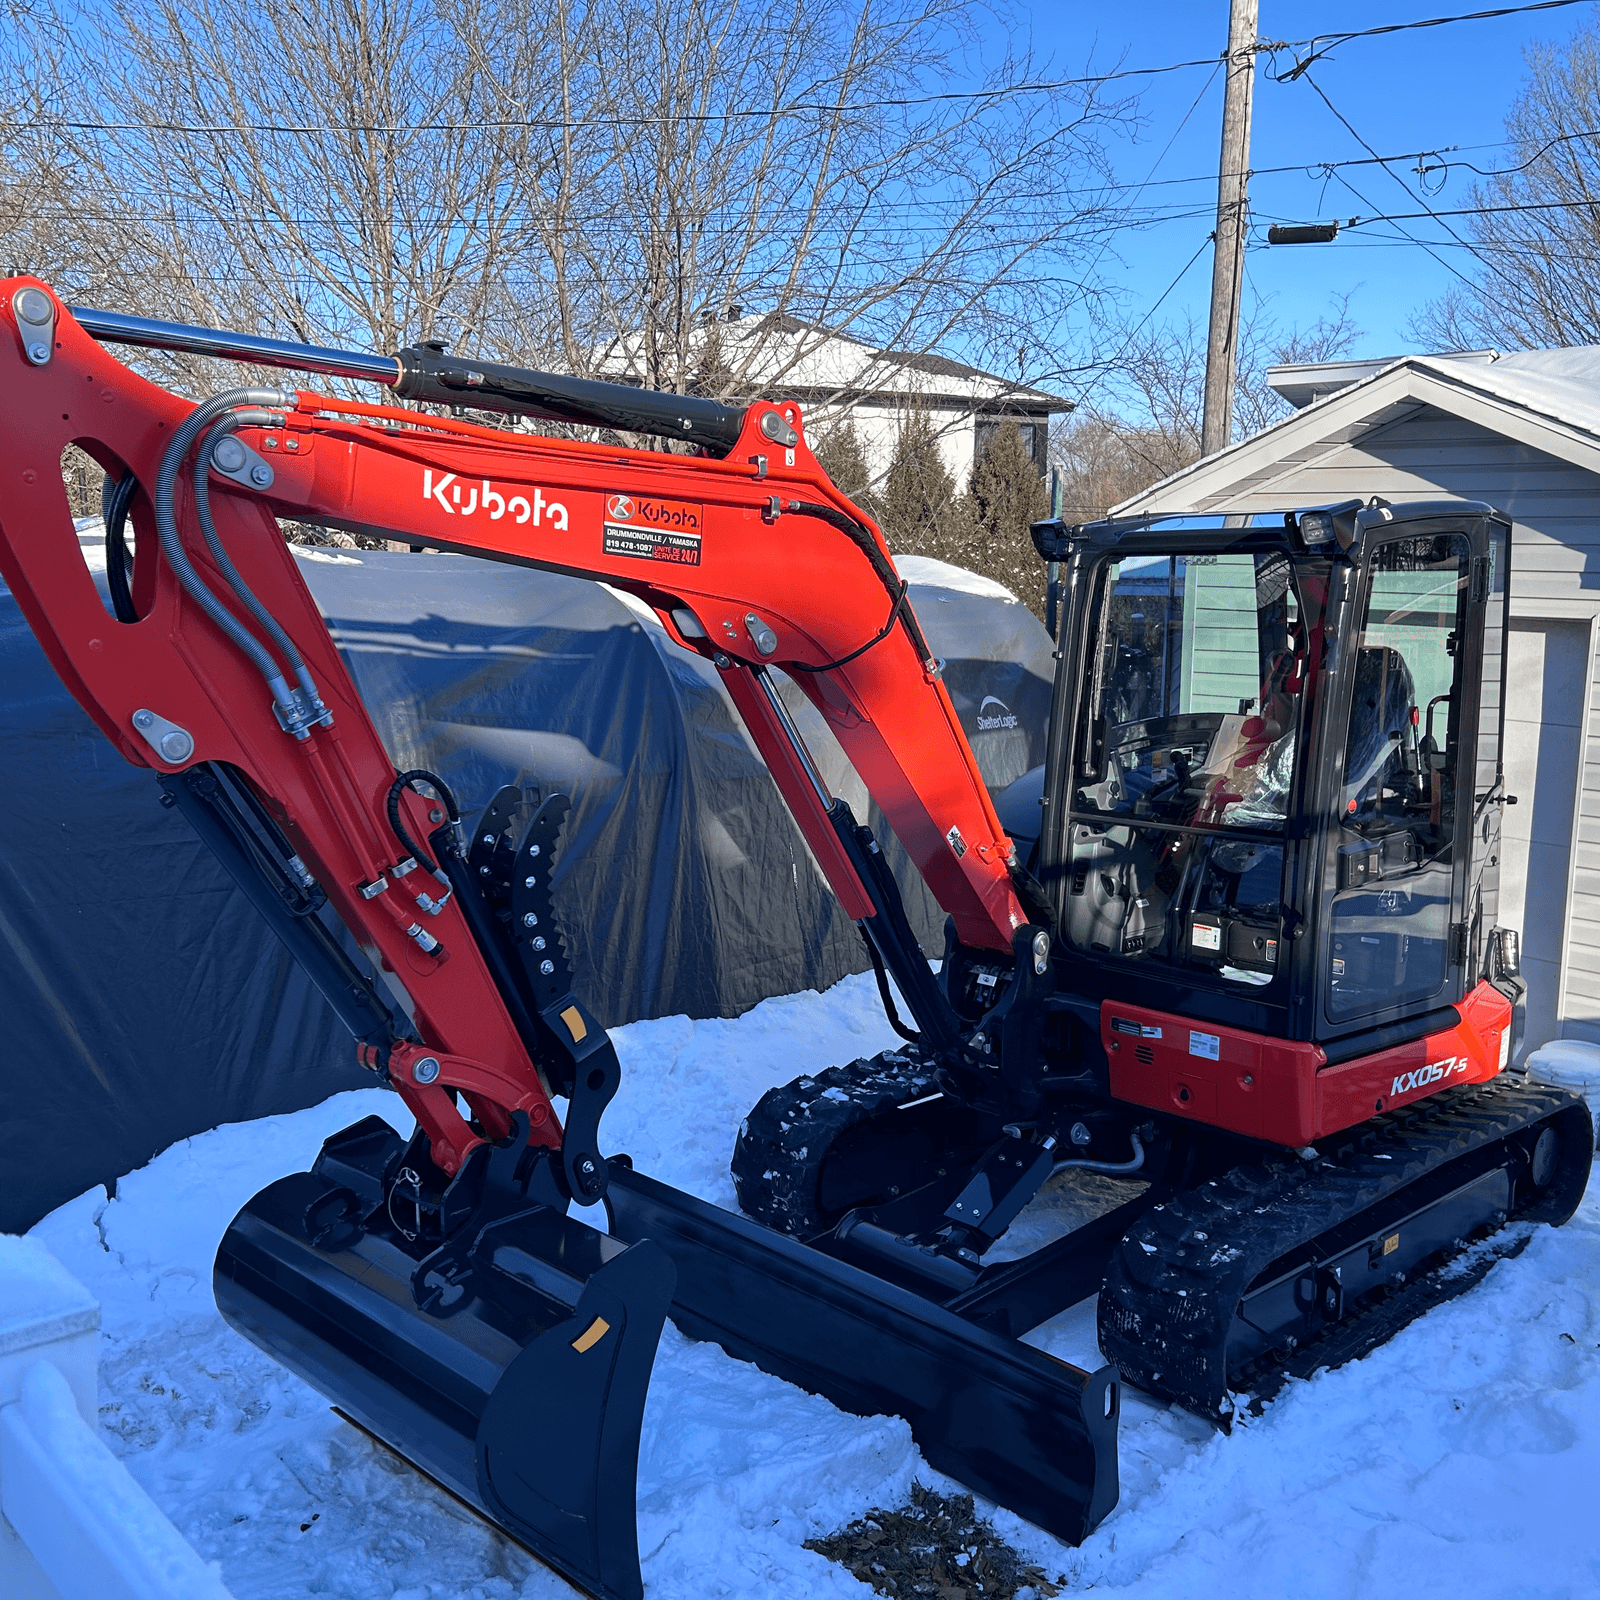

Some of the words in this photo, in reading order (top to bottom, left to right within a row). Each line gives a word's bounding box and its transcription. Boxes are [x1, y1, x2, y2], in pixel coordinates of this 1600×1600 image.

[423, 469, 568, 531] Kubota
[638, 501, 698, 528] Kubota
[606, 528, 662, 543] DRUMMONDVILLE
[668, 536, 698, 547] YAMASKA
[606, 539, 619, 547] 819
[620, 541, 652, 552] 478-1097
[654, 551, 680, 561] SERVICE
[681, 549, 698, 563] 24/7
[977, 713, 1018, 731] ShelterLogic
[1390, 1056, 1468, 1097] KX057-5
